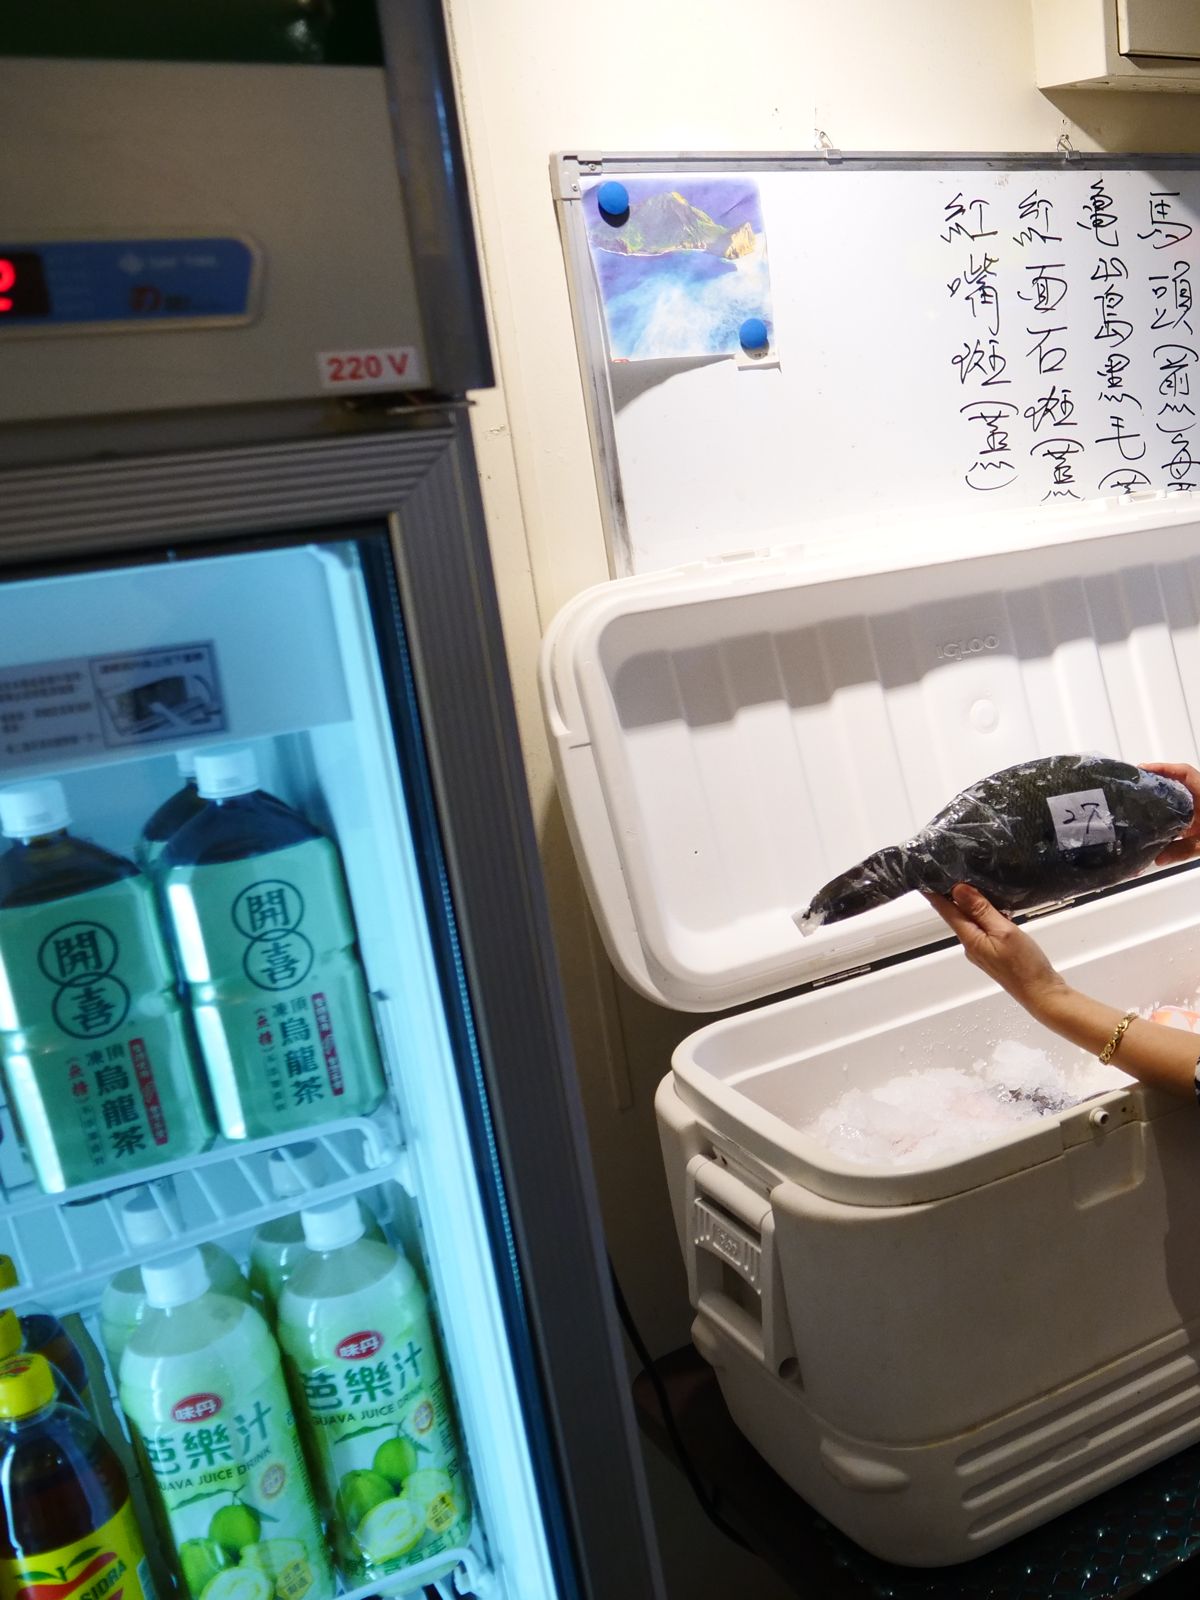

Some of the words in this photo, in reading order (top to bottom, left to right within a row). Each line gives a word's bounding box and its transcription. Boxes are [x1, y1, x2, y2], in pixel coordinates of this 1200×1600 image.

[326, 353, 384, 382] 220
[387, 352, 409, 377] V
[280, 1018, 325, 1107] 烏龍茶
[94, 1066, 147, 1159] 烏龍茶
[300, 1341, 422, 1411] 芭樂汁
[143, 1401, 271, 1475] 芭樂汁
[360, 1404, 395, 1420] JUICE
[158, 1478, 193, 1492] UAVA
[198, 1468, 233, 1486] JUICE
[237, 1445, 272, 1476] DRINK
[80, 1559, 127, 1600] SIDRA
